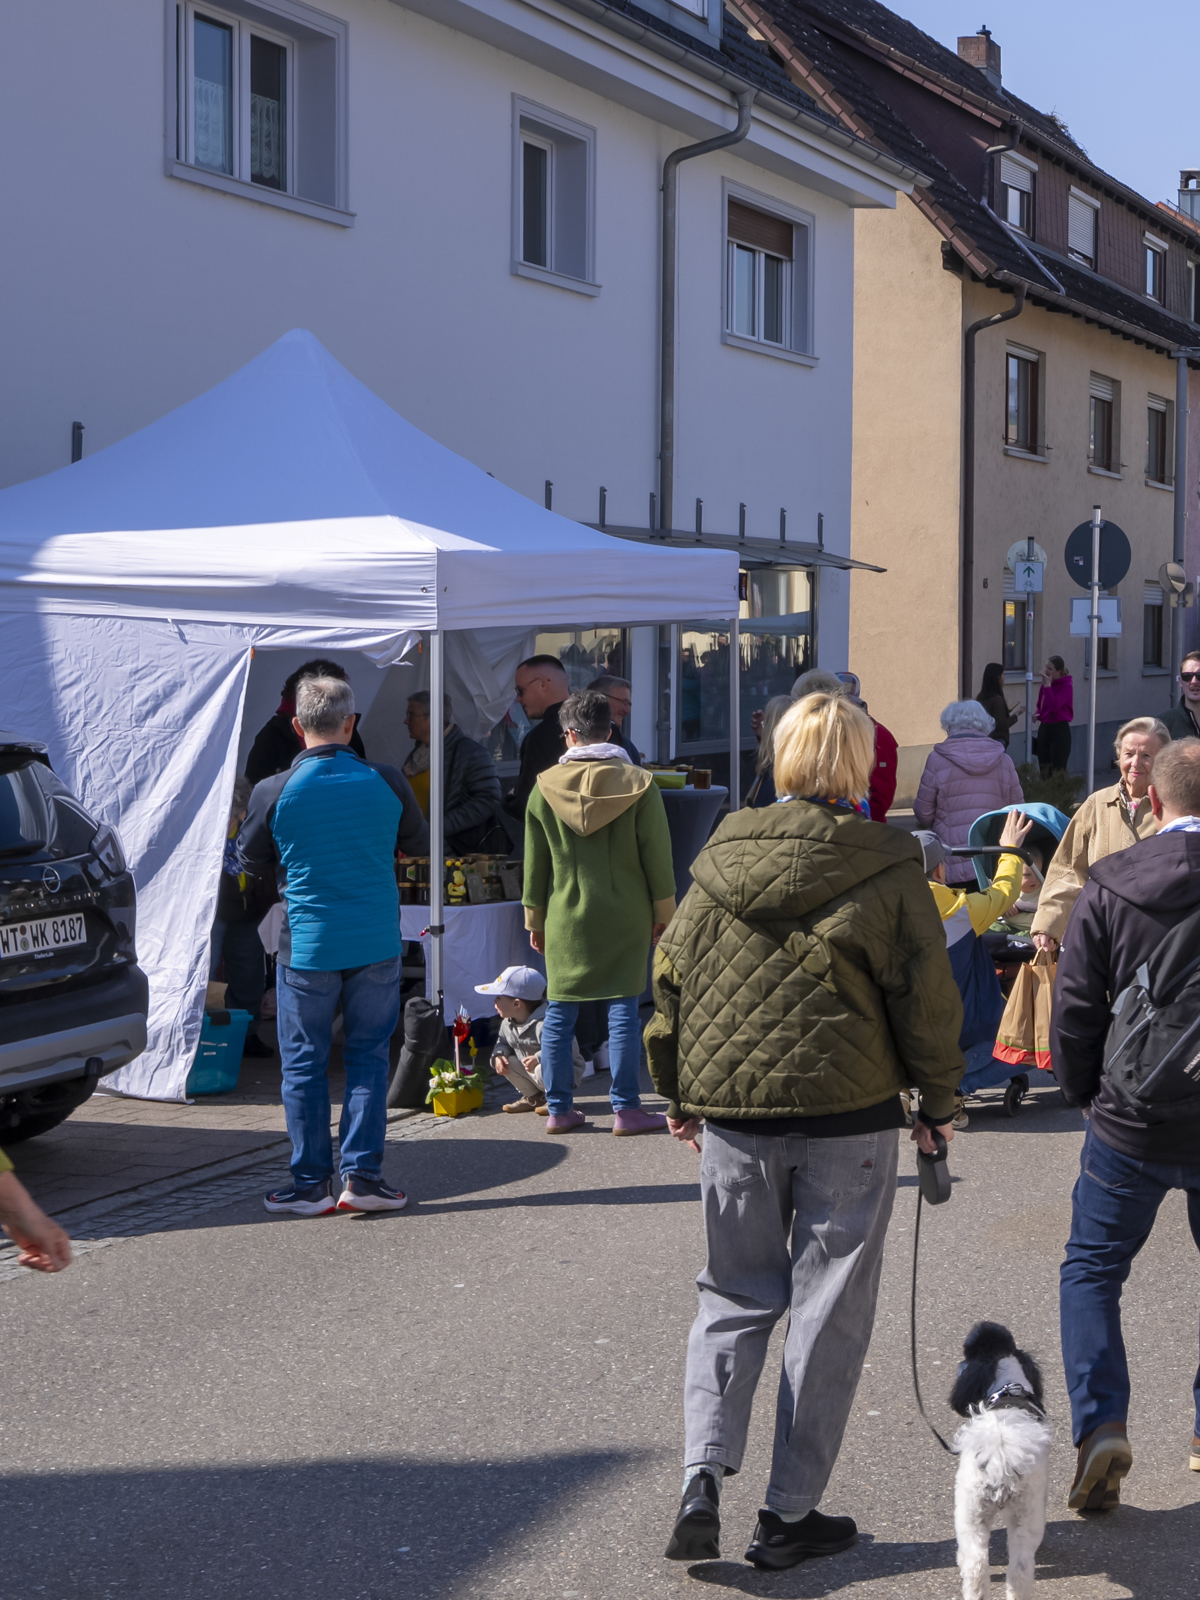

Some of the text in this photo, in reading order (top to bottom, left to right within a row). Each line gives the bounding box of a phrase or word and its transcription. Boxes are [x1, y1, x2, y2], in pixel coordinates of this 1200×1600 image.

[0, 916, 83, 954] WT WK 8187
